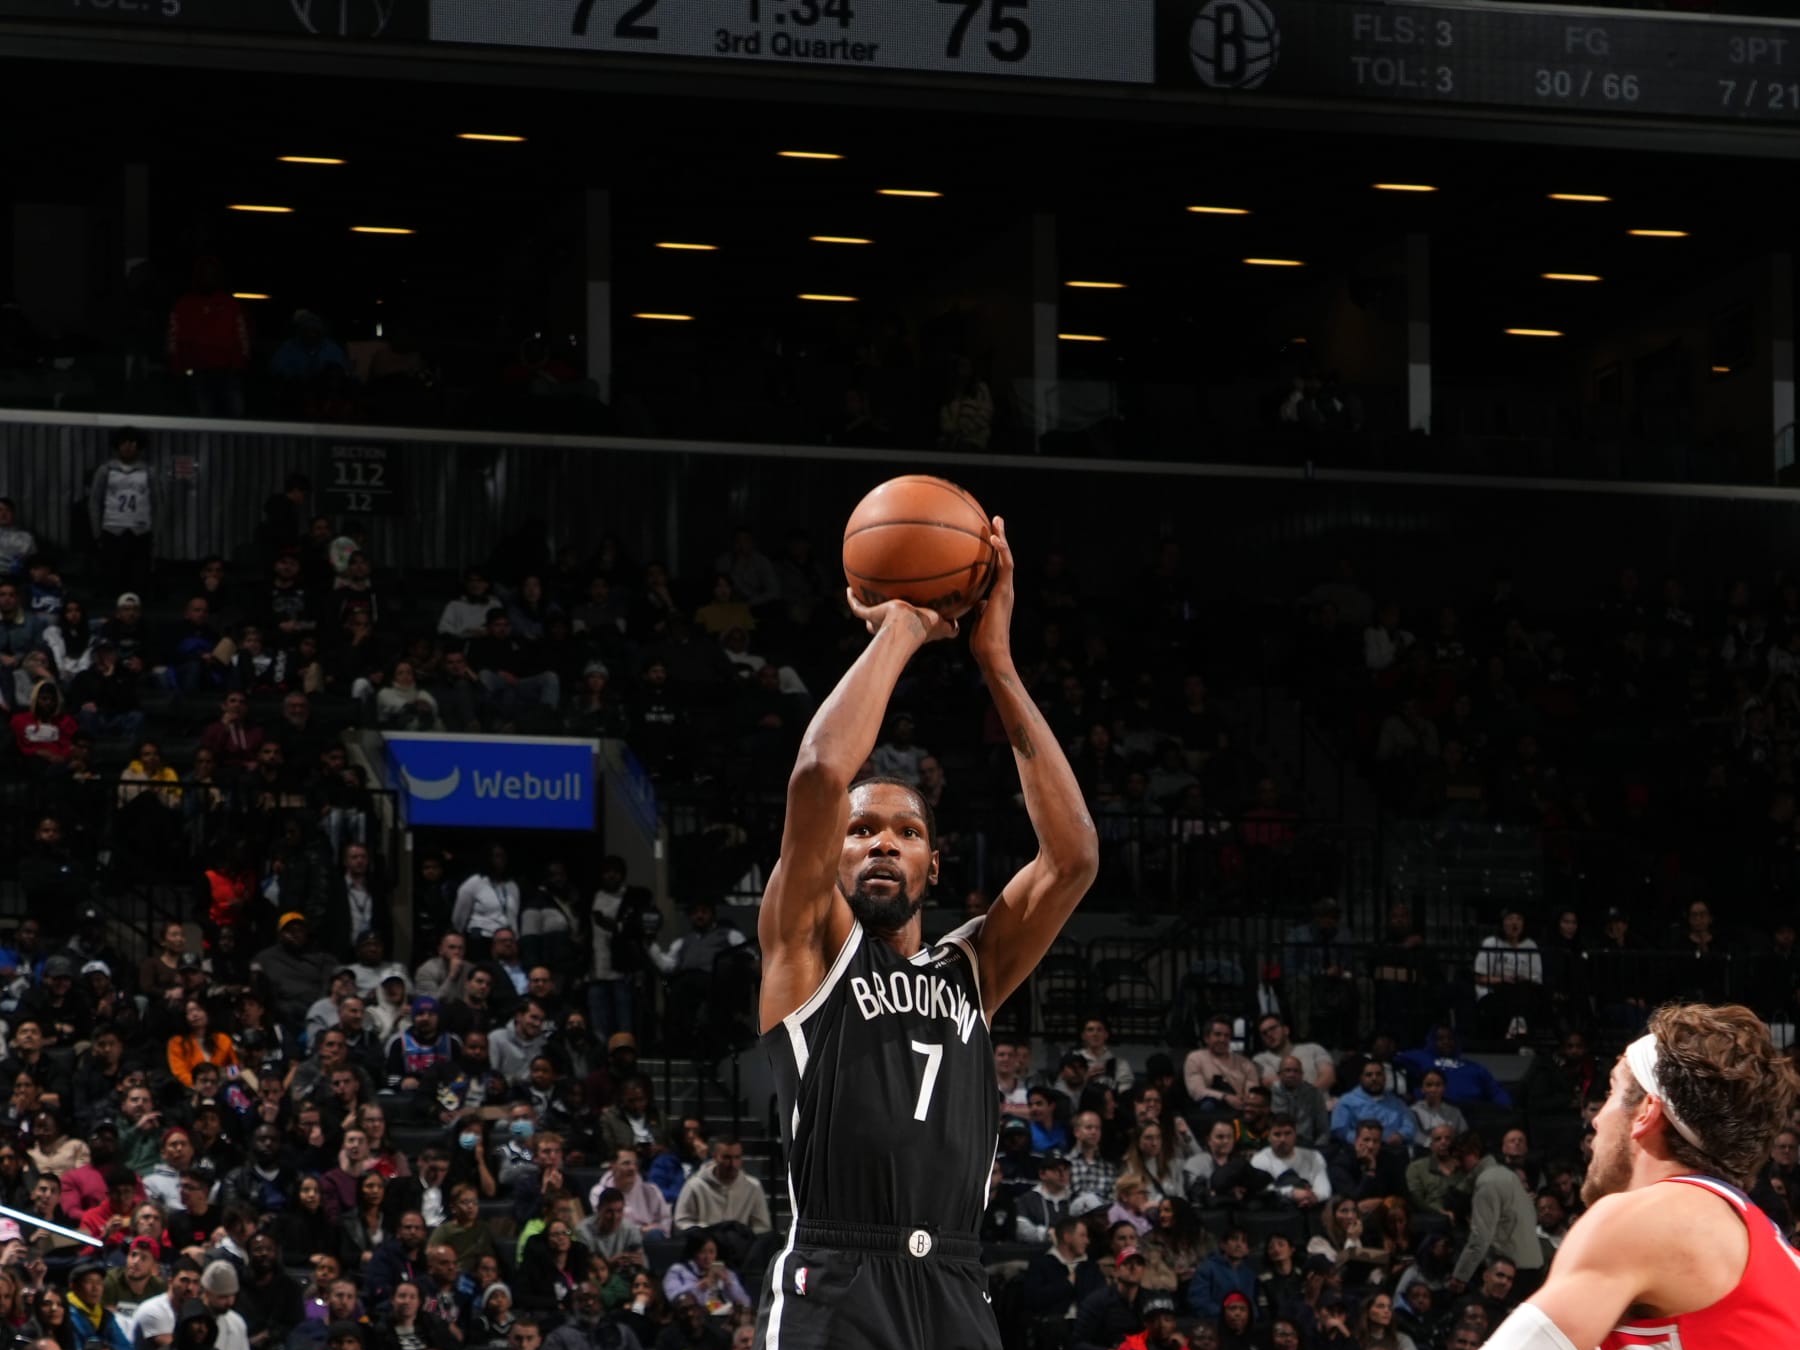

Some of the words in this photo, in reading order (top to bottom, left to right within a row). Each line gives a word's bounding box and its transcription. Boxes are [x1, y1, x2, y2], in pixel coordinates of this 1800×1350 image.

[715, 28, 761, 54] 3rd
[771, 31, 879, 62] Quarter
[944, 0, 1031, 63] 75
[1352, 13, 1425, 44] FLS:
[1436, 20, 1454, 48] 3
[1565, 26, 1609, 56] FG
[1728, 36, 1789, 66] 3PT
[1350, 55, 1427, 90] TOL:
[1436, 65, 1454, 93] 3
[1535, 69, 1571, 97] 30
[1601, 73, 1640, 101] 66
[1718, 79, 1737, 105] 7
[1767, 82, 1800, 110] 21
[333, 461, 385, 487] 112
[345, 493, 373, 512] 12
[473, 769, 582, 801] Webull
[850, 971, 979, 1045] BROOKLYN
[911, 1039, 944, 1122] 7
